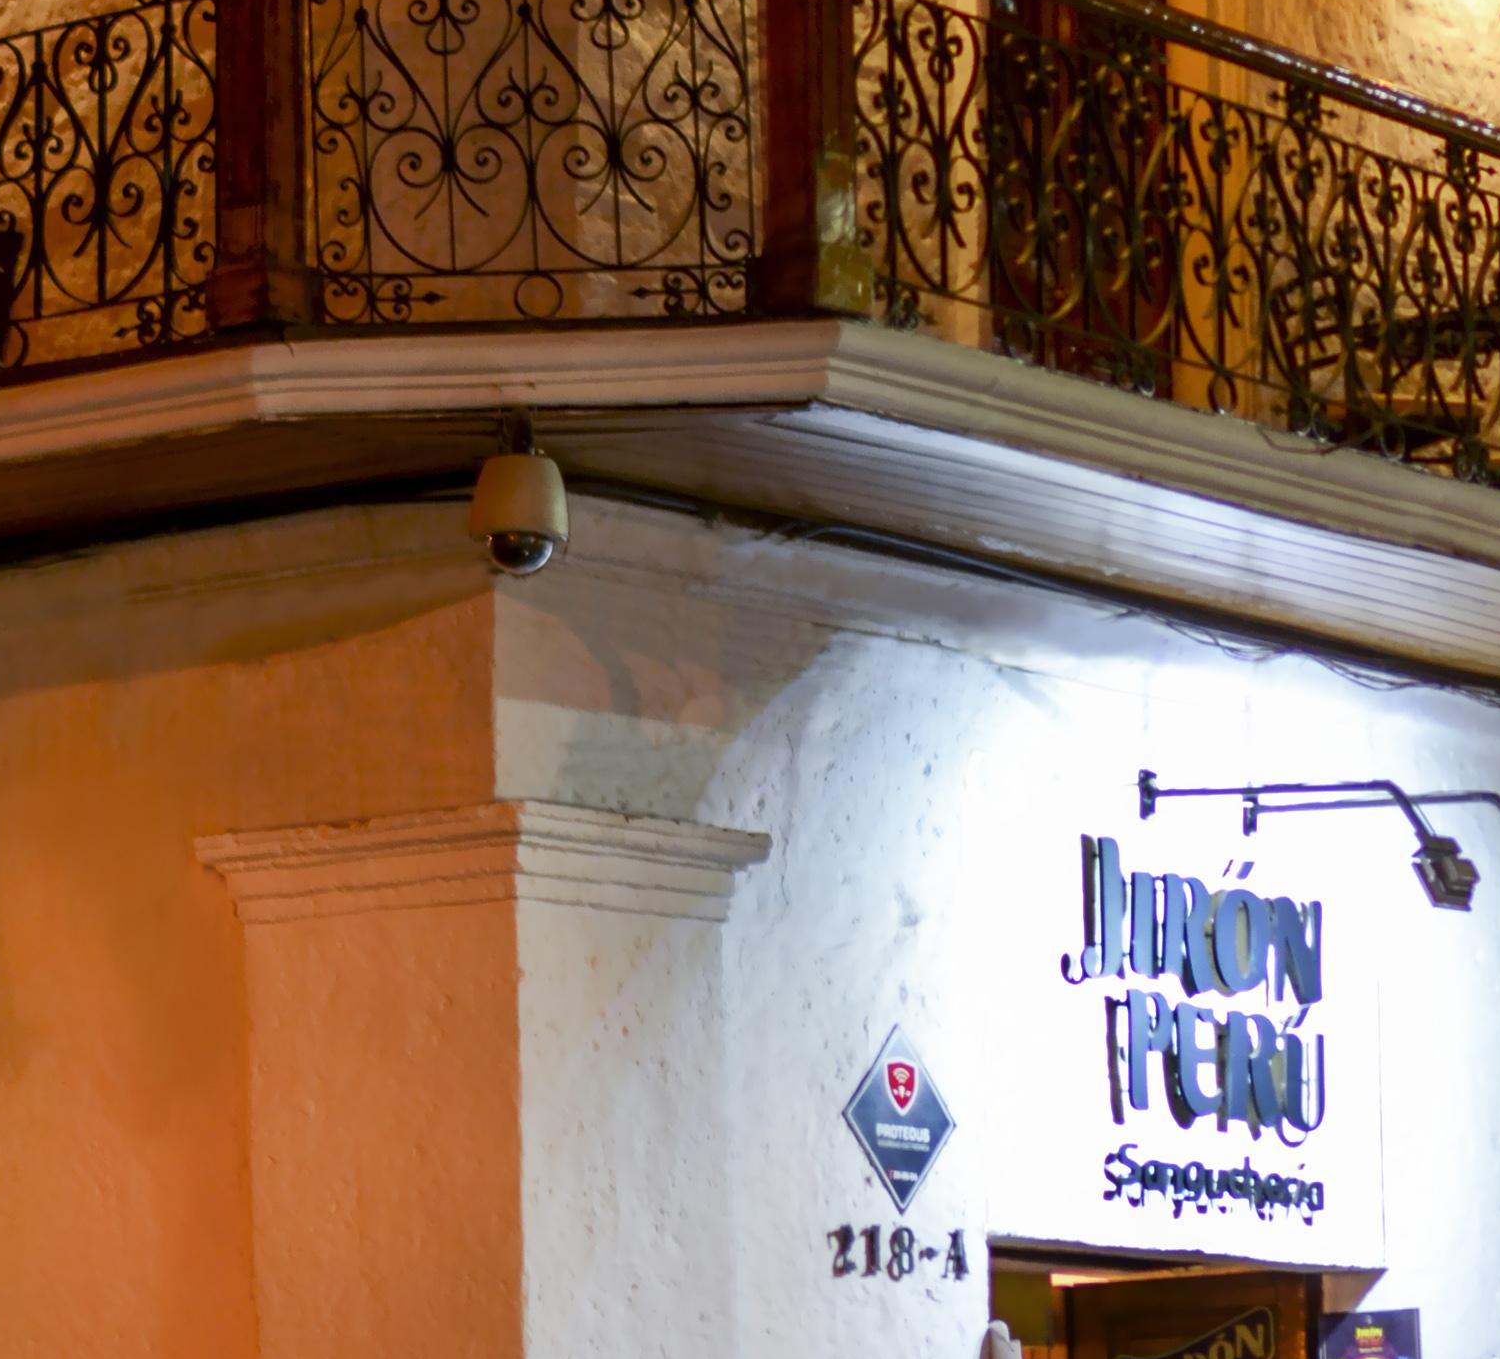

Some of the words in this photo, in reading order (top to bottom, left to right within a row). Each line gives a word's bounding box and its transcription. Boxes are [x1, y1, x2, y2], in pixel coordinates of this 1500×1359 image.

[1060, 833, 1323, 999] JIRÓN
[1104, 988, 1325, 1147] PERÚ
[826, 1224, 970, 1282] 218-A
